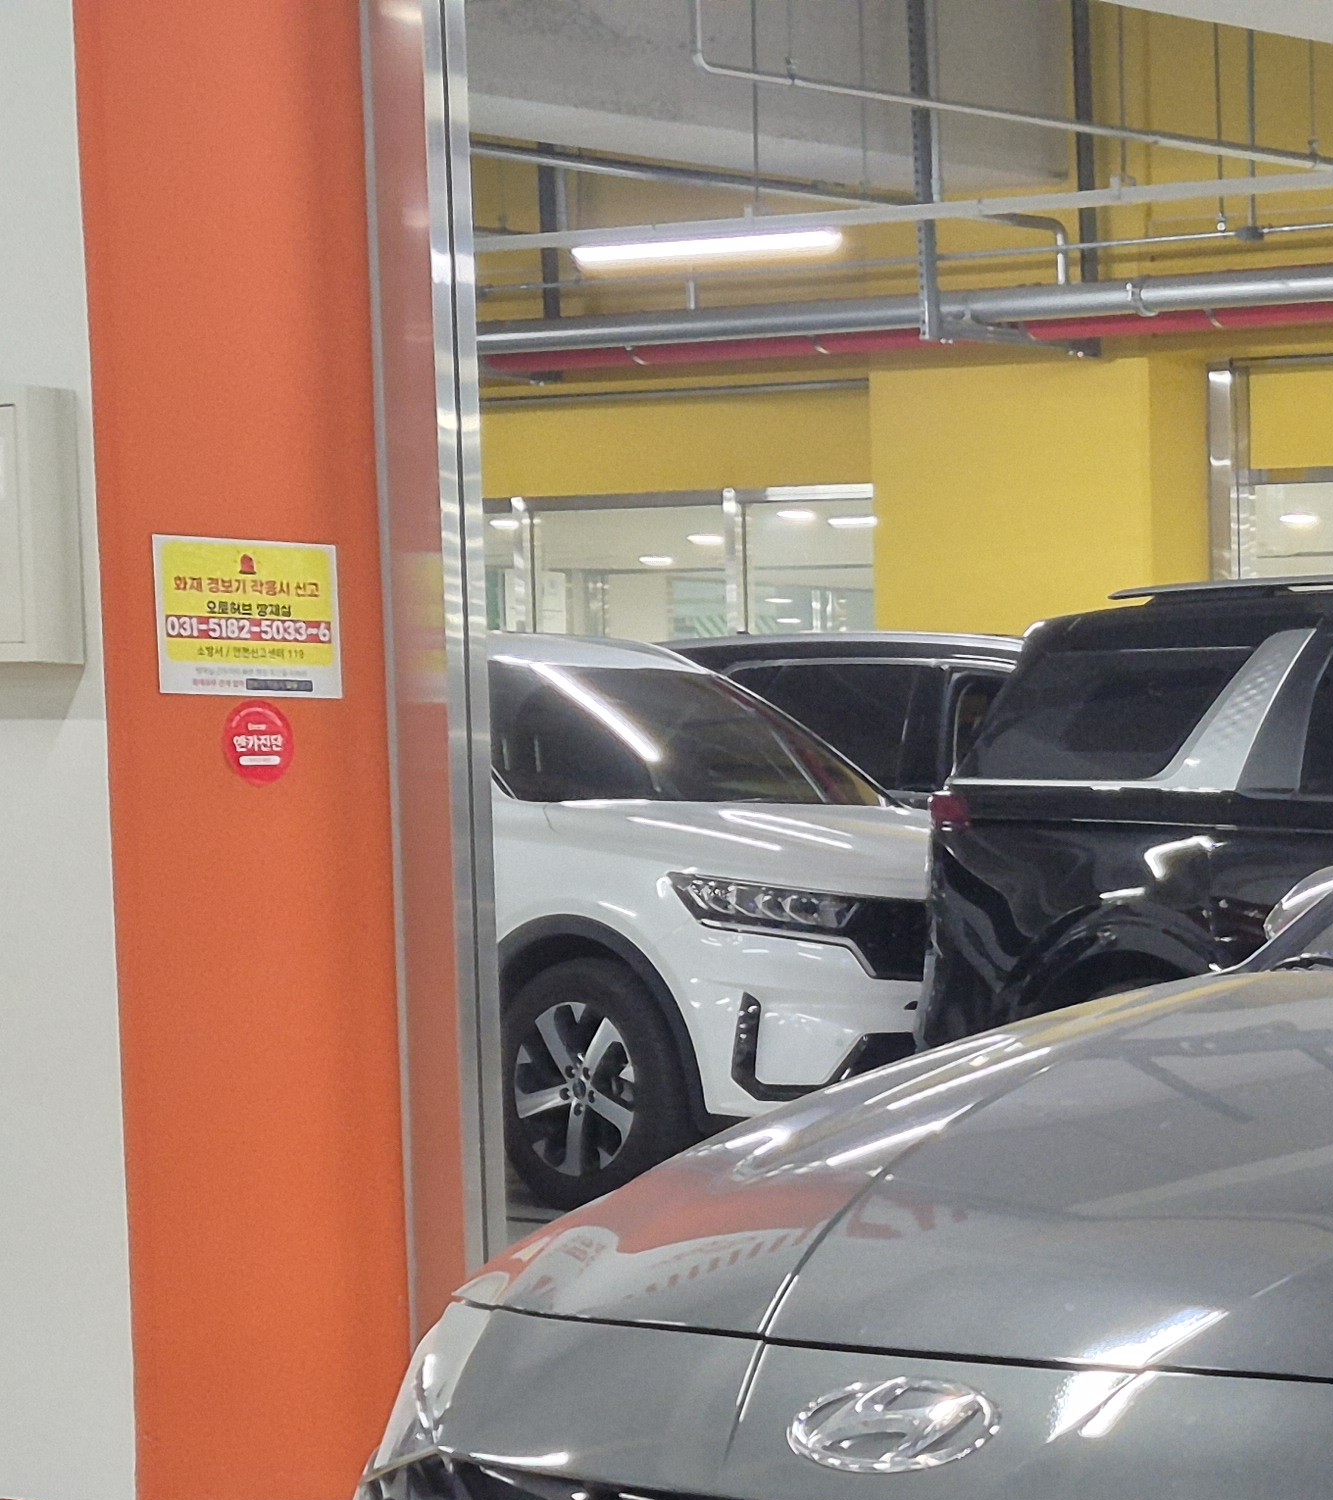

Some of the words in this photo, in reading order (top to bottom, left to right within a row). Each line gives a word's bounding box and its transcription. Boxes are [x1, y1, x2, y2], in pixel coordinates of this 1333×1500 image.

[173, 575, 203, 593] 화재
[206, 577, 247, 595] 경보기
[294, 581, 320, 598] 신고
